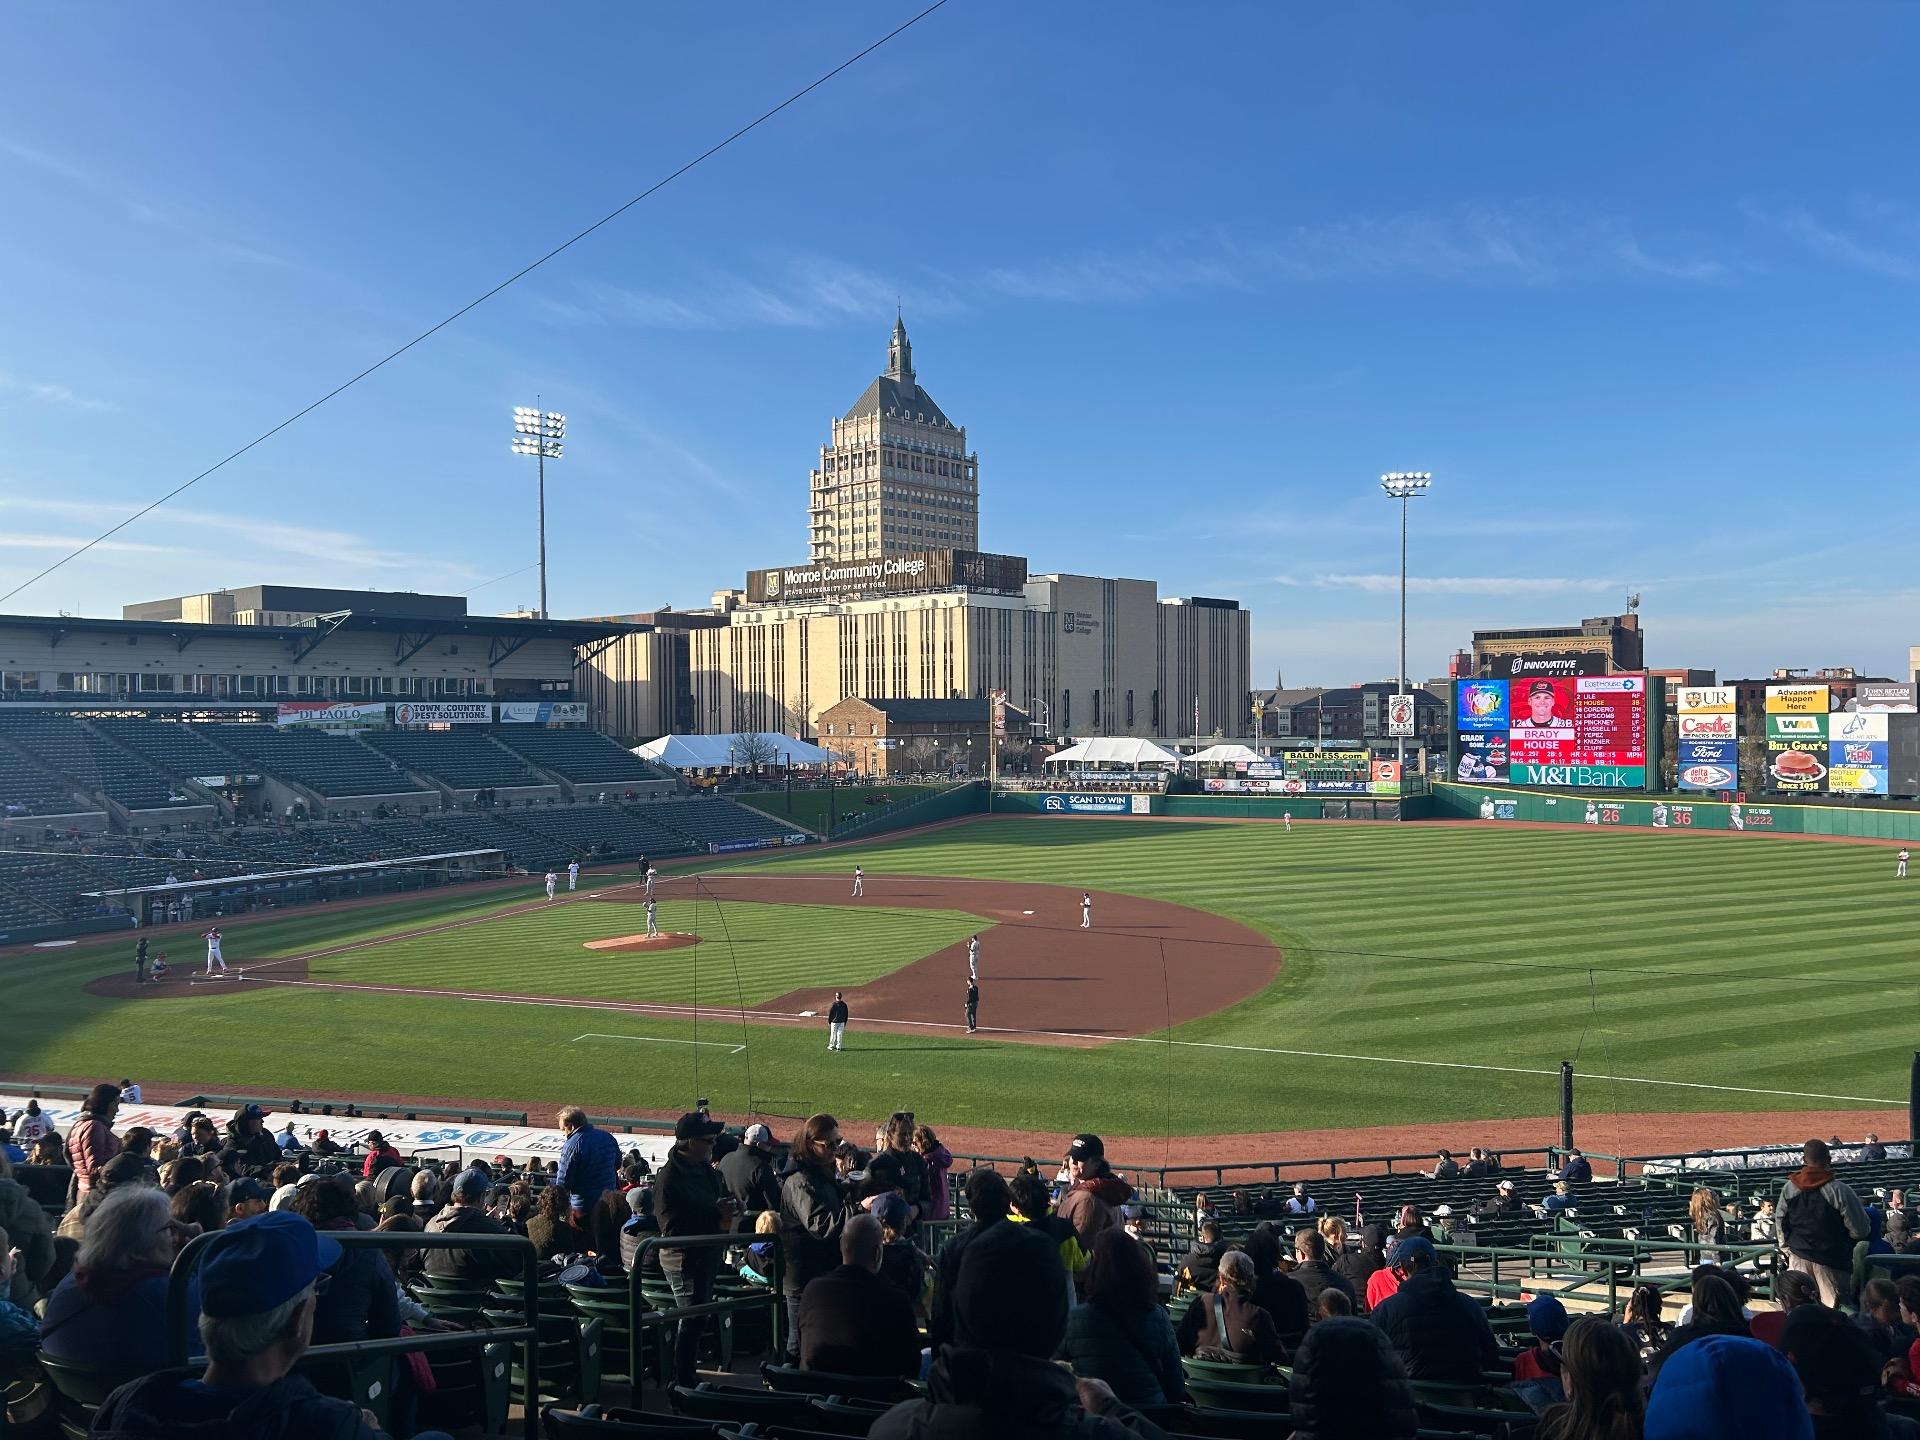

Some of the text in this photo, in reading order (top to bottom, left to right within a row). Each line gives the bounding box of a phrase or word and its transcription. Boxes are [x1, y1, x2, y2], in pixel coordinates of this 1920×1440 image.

[784, 558, 924, 584] Monroe Community College
[804, 585, 841, 594] UNIVERSITY
[853, 582, 867, 590] NEW
[1524, 660, 1577, 670] INNOVATIVE
[1863, 688, 1883, 697] JOHN
[1704, 692, 1728, 704] UR
[300, 710, 360, 719] DI PAOLO
[1682, 715, 1732, 733] Castle
[1782, 720, 1814, 728] WM
[1524, 730, 1560, 738] BRADY
[1524, 741, 1560, 749] HOUSE
[1768, 740, 1828, 750] BILL GRAY'S
[1692, 746, 1722, 757] Ford
[1850, 750, 1872, 761] FAN
[1526, 766, 1628, 787] M&T Bank
[1690, 768, 1708, 776] delta
[1776, 781, 1798, 789] SINCE
[1047, 800, 1064, 809] ESL
[1069, 796, 1125, 804] SCAN TO WIN
[1496, 804, 1514, 818] 42
[1602, 809, 1620, 822] 26
[1673, 812, 1692, 825] 36
[1745, 816, 1773, 825] 8,222
[129, 1093, 136, 1101] 5
[25, 1125, 40, 1137] 36
